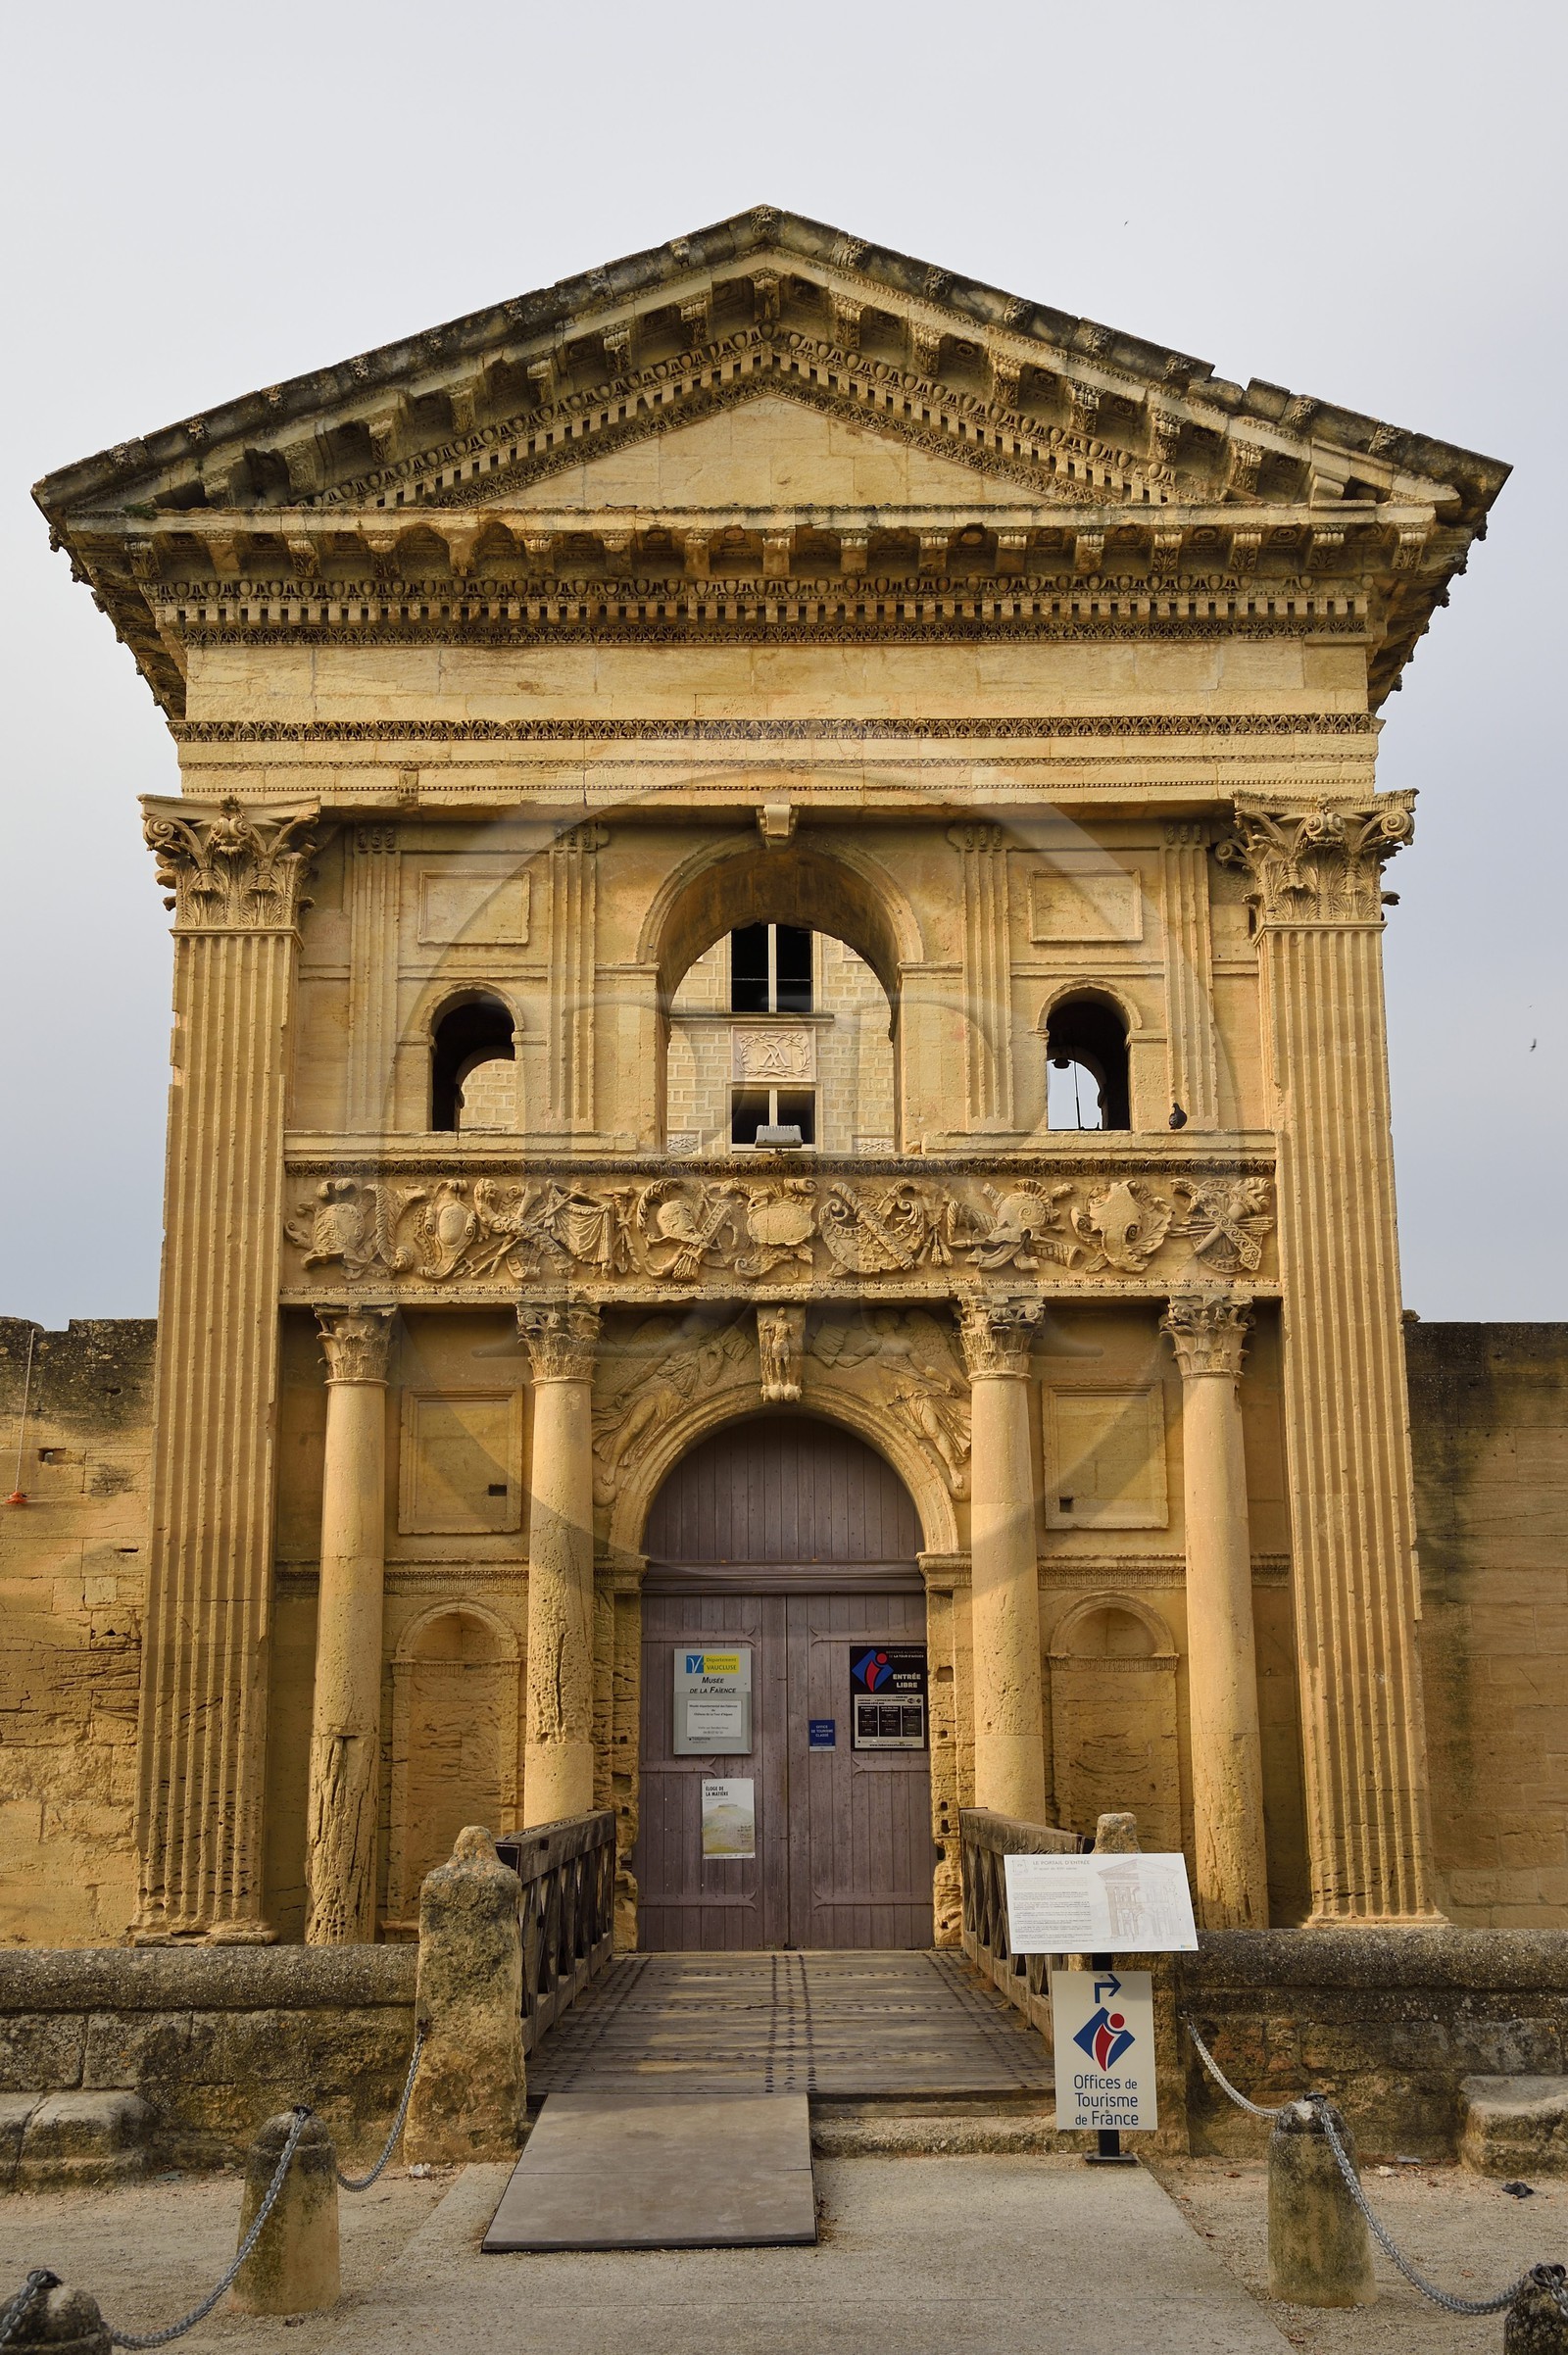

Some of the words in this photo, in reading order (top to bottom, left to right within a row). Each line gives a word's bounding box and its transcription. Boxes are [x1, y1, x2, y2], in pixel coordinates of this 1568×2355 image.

[1073, 2074, 1121, 2089] Offices
[1124, 2079, 1138, 2089] de
[1075, 2092, 1139, 2107] Tourisme
[1075, 2114, 1088, 2125] de
[1091, 2110, 1139, 2126] France
